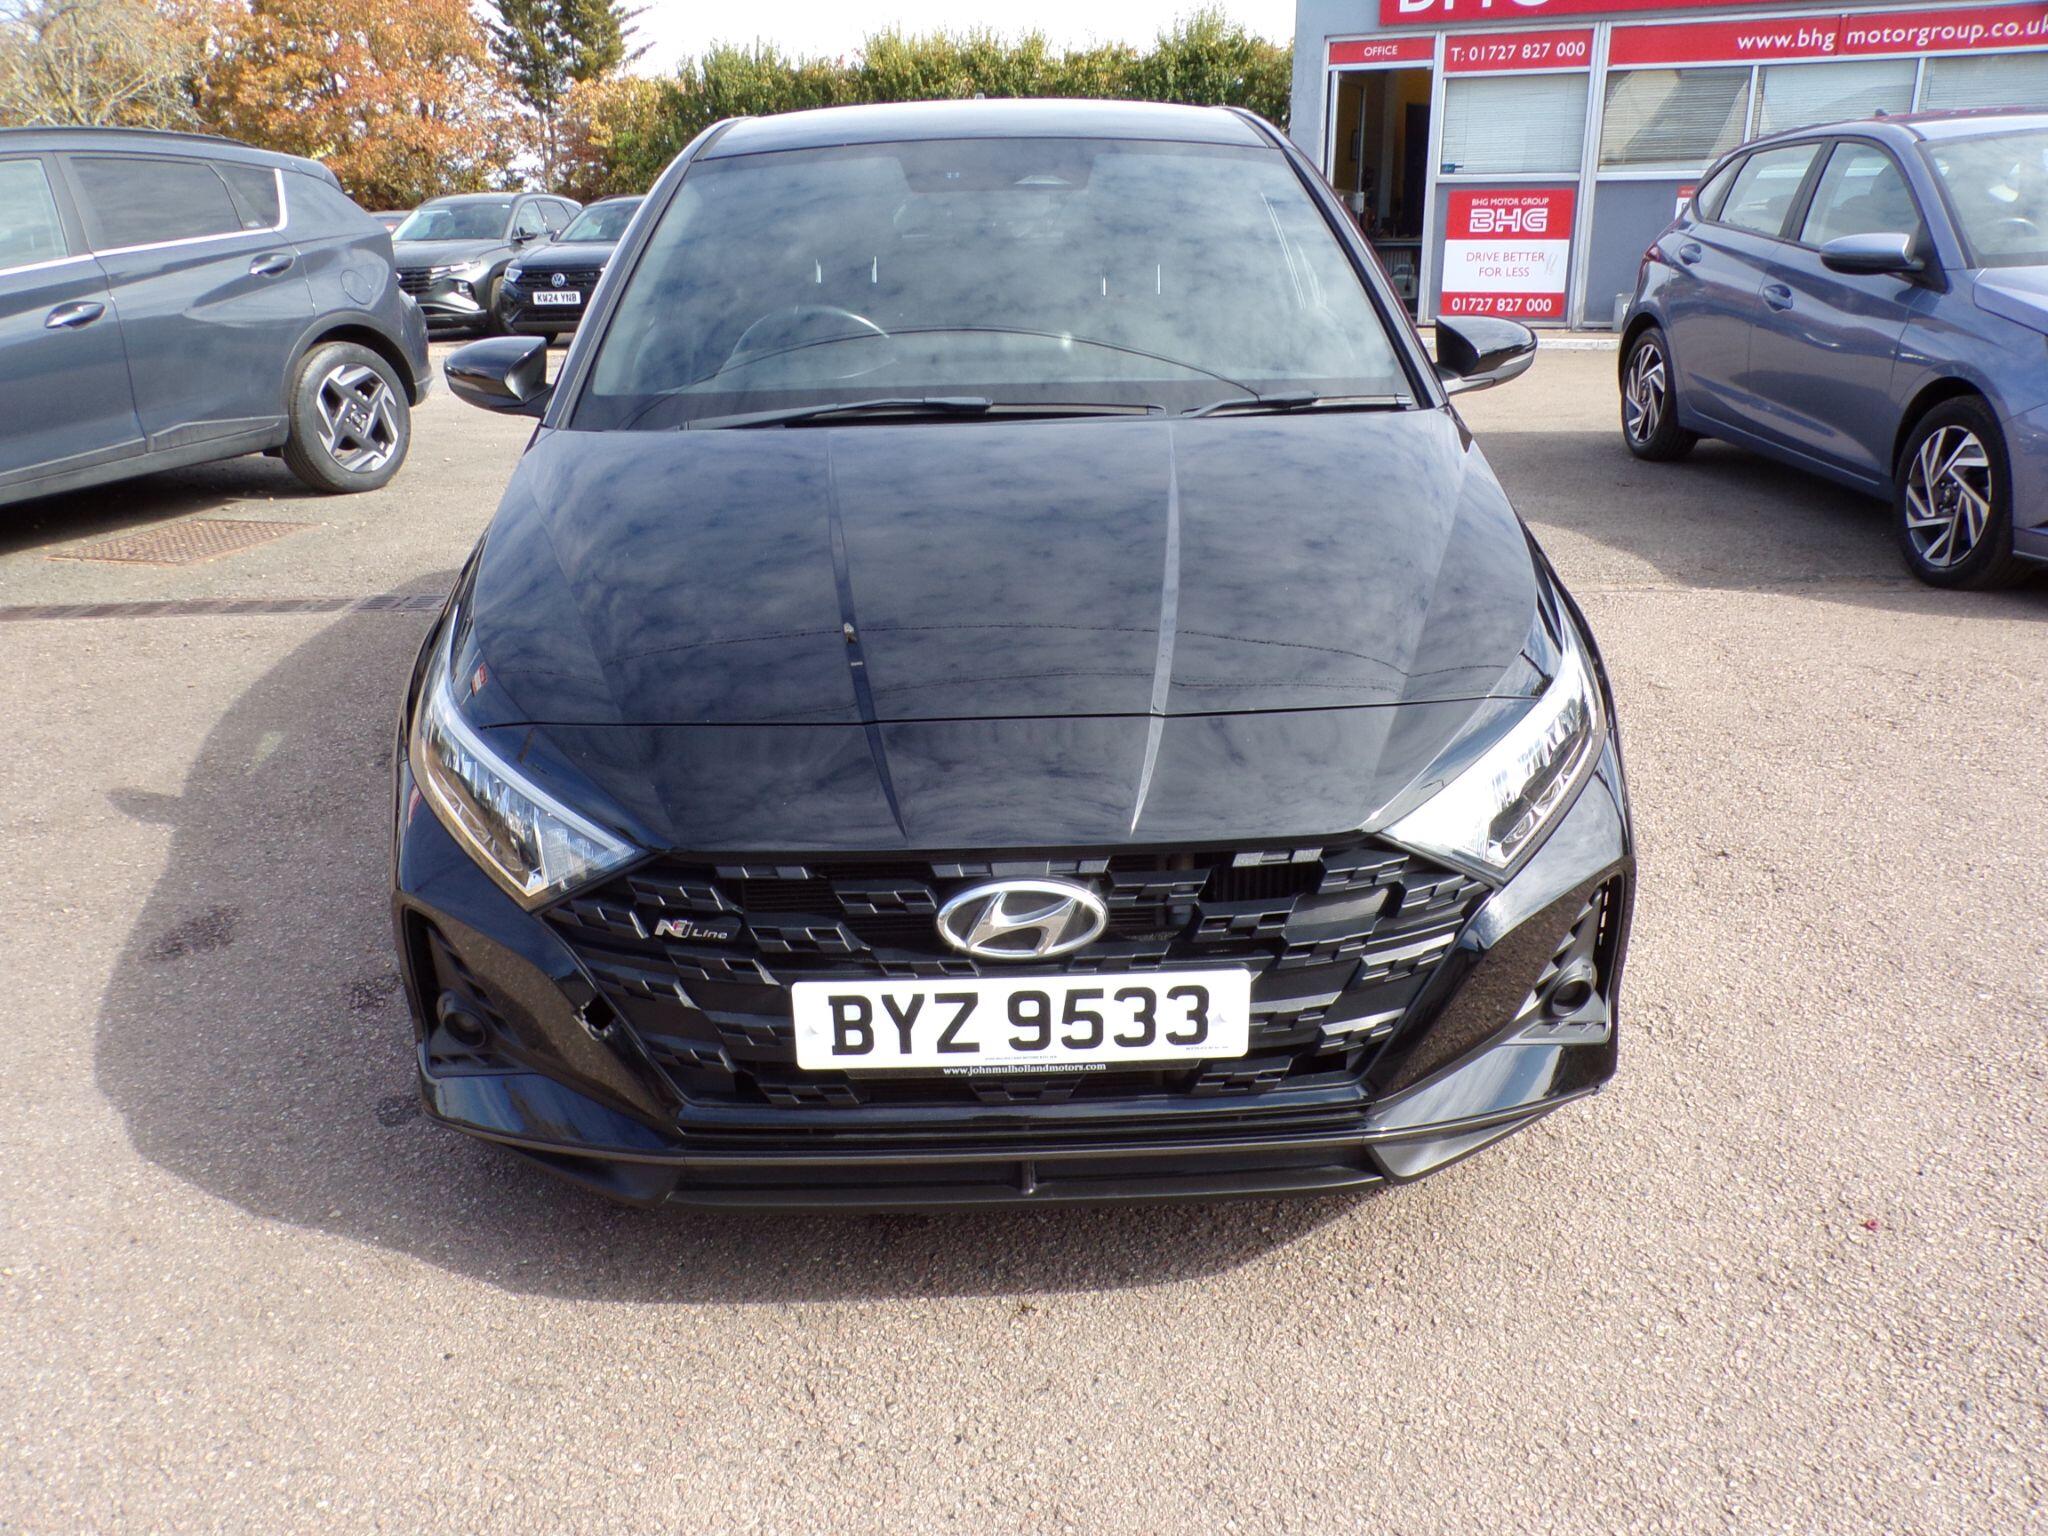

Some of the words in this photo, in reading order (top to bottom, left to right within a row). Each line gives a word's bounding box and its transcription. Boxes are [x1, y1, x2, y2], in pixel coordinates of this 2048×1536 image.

[1737, 28, 1836, 51] www.bhg
[1364, 45, 1398, 57] OFFICE
[1451, 47, 1465, 62] T:
[1469, 44, 1516, 61] 01727
[1522, 43, 1550, 60] 827
[1556, 41, 1586, 57] 000
[1471, 198, 1489, 206] BHG
[1490, 198, 1519, 206] MOTOR
[1521, 197, 1549, 205] GROUP
[1469, 208, 1549, 233] BHG
[1466, 252, 1500, 262] DRIVE
[1503, 252, 1545, 262] BETTER
[1479, 267, 1502, 277] FOR
[1506, 267, 1530, 277] LESS
[537, 293, 558, 302] KW24
[561, 293, 577, 302] YNB
[1452, 298, 1493, 311] 01727
[1496, 298, 1523, 312] 827
[1526, 298, 1552, 312] 000
[692, 928, 728, 939] Line
[828, 992, 981, 1055] BYZ
[1007, 985, 1209, 1051] 9533
[943, 1062, 1107, 1076] www.johnmulhollandmotors.com
